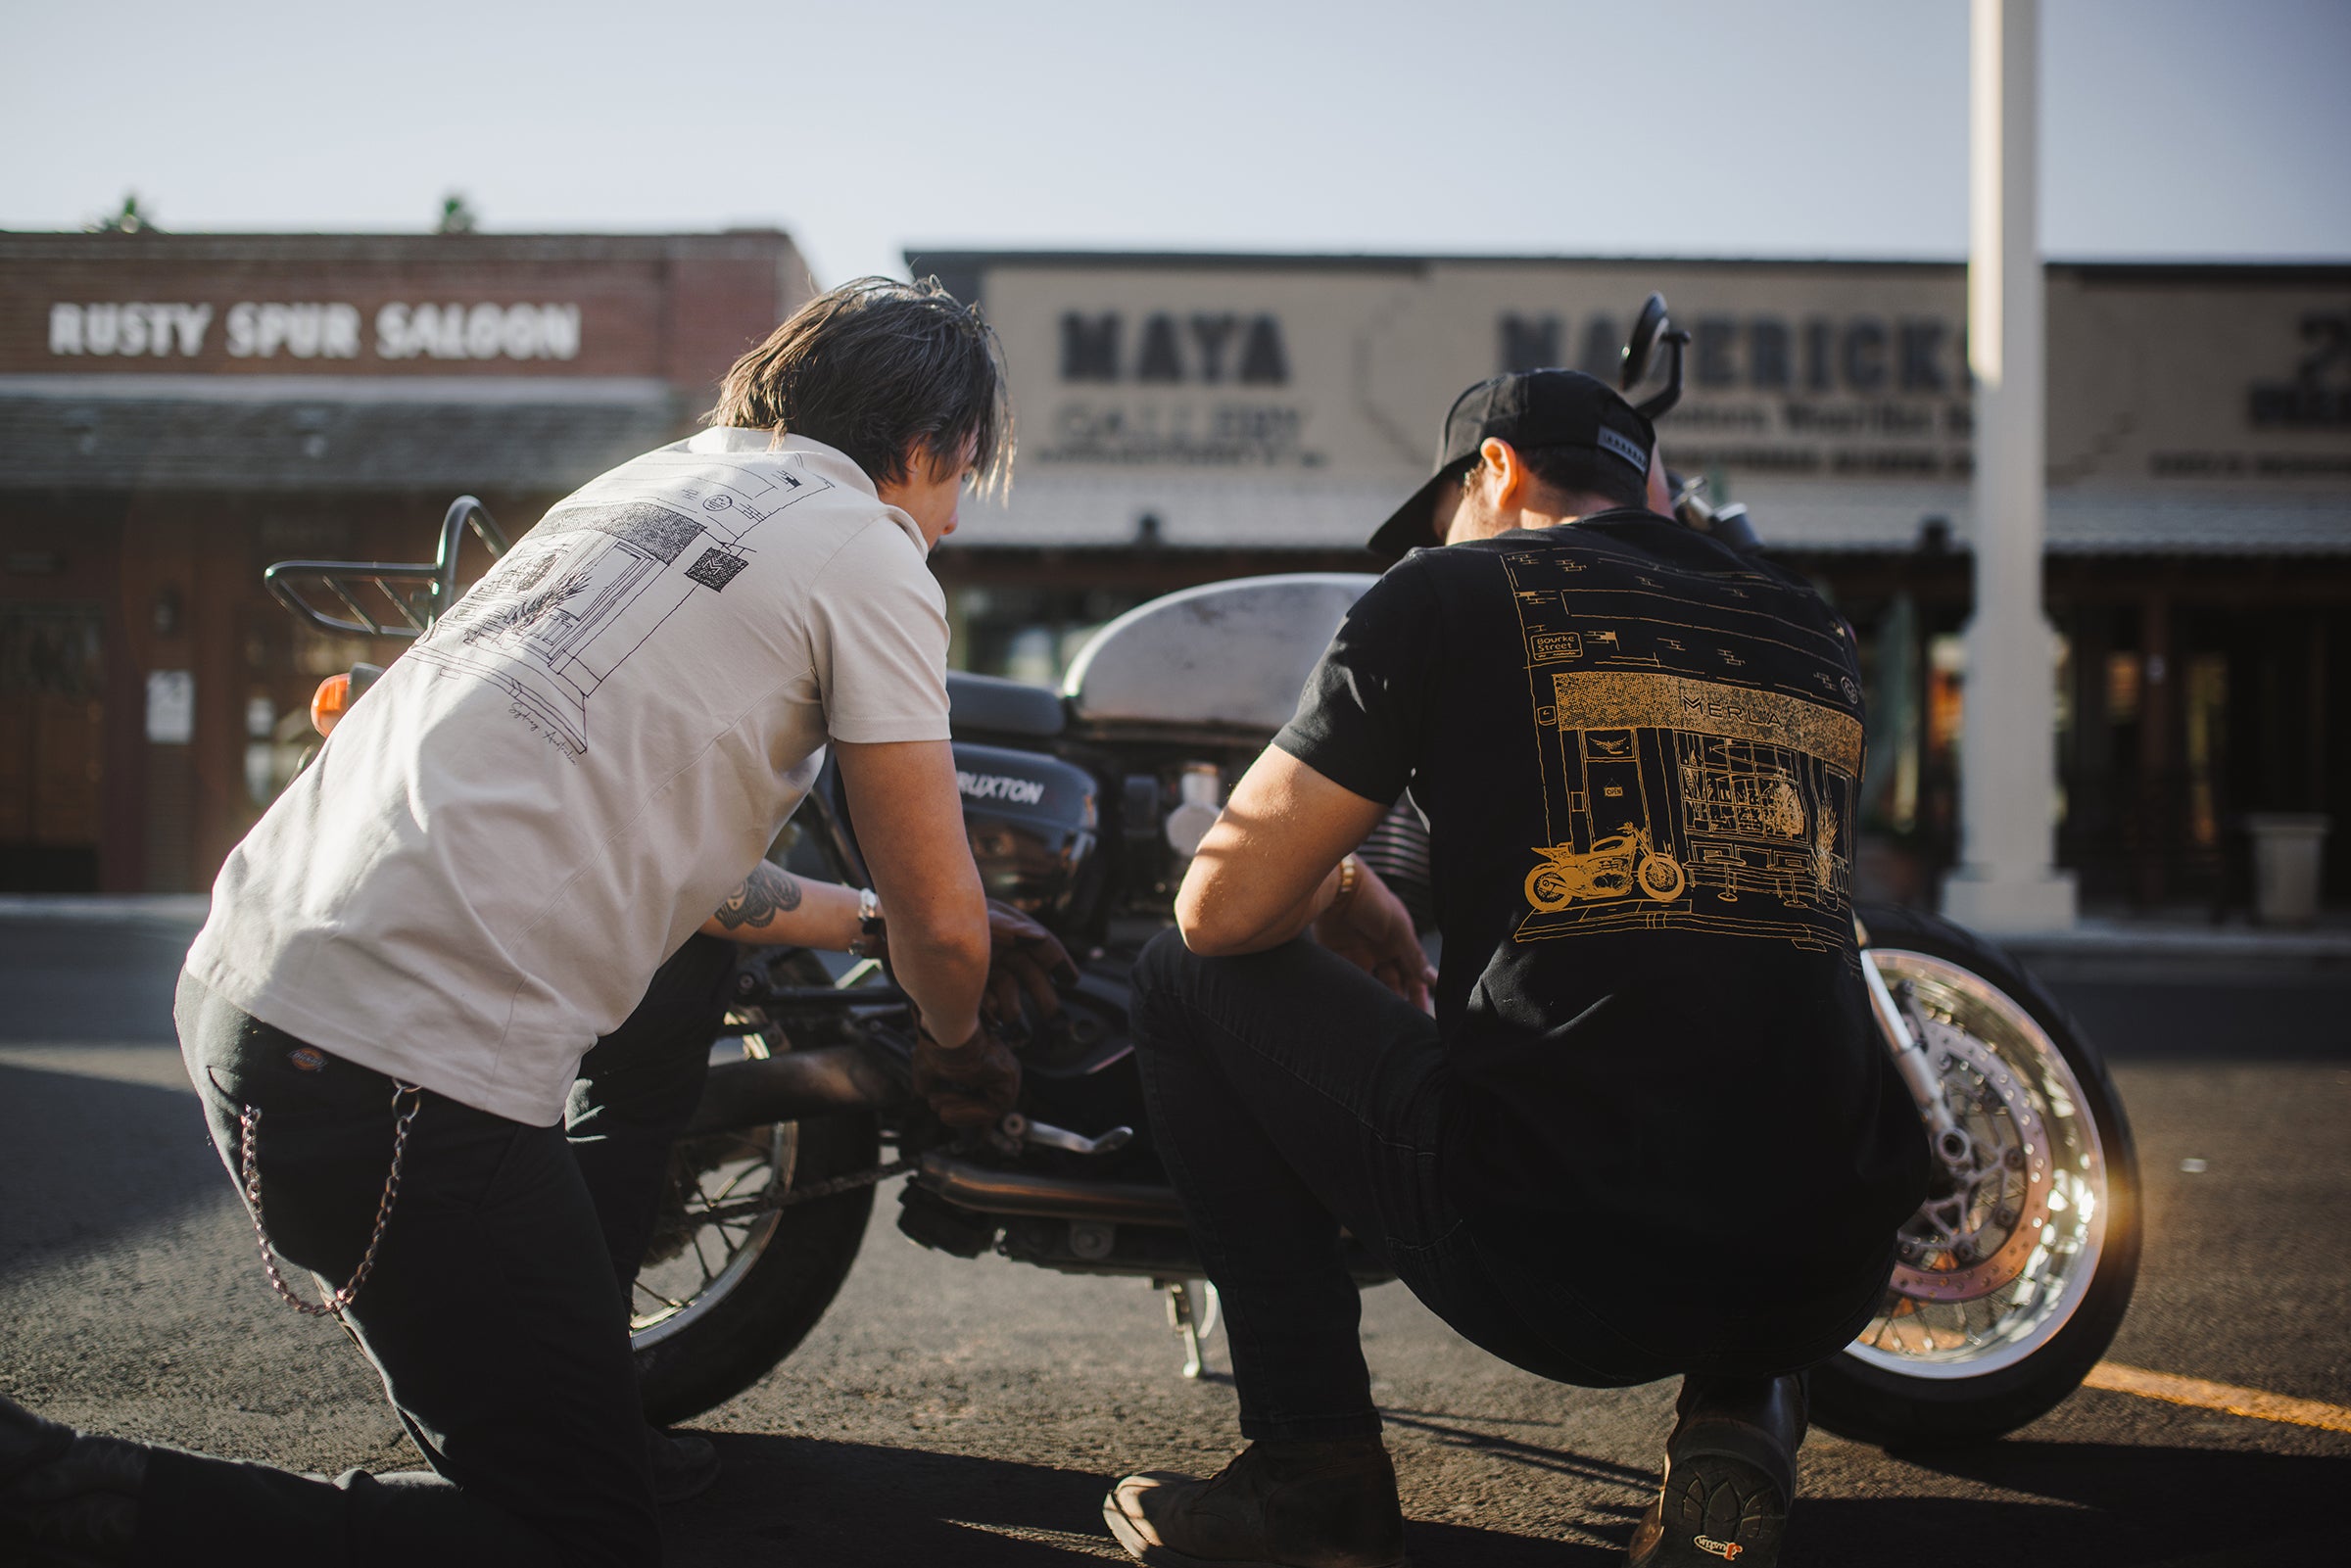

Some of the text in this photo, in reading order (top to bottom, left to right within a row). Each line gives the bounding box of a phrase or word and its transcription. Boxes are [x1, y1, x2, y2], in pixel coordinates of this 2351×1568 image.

[49, 302, 582, 359] RUSTY SPUR SALOON
[1060, 311, 1291, 383] MAYA
[1499, 311, 1972, 392] MAERICK
[1537, 636, 1575, 644] Bourke
[1538, 642, 1573, 651] Street
[1683, 694, 1784, 728] MERLA
